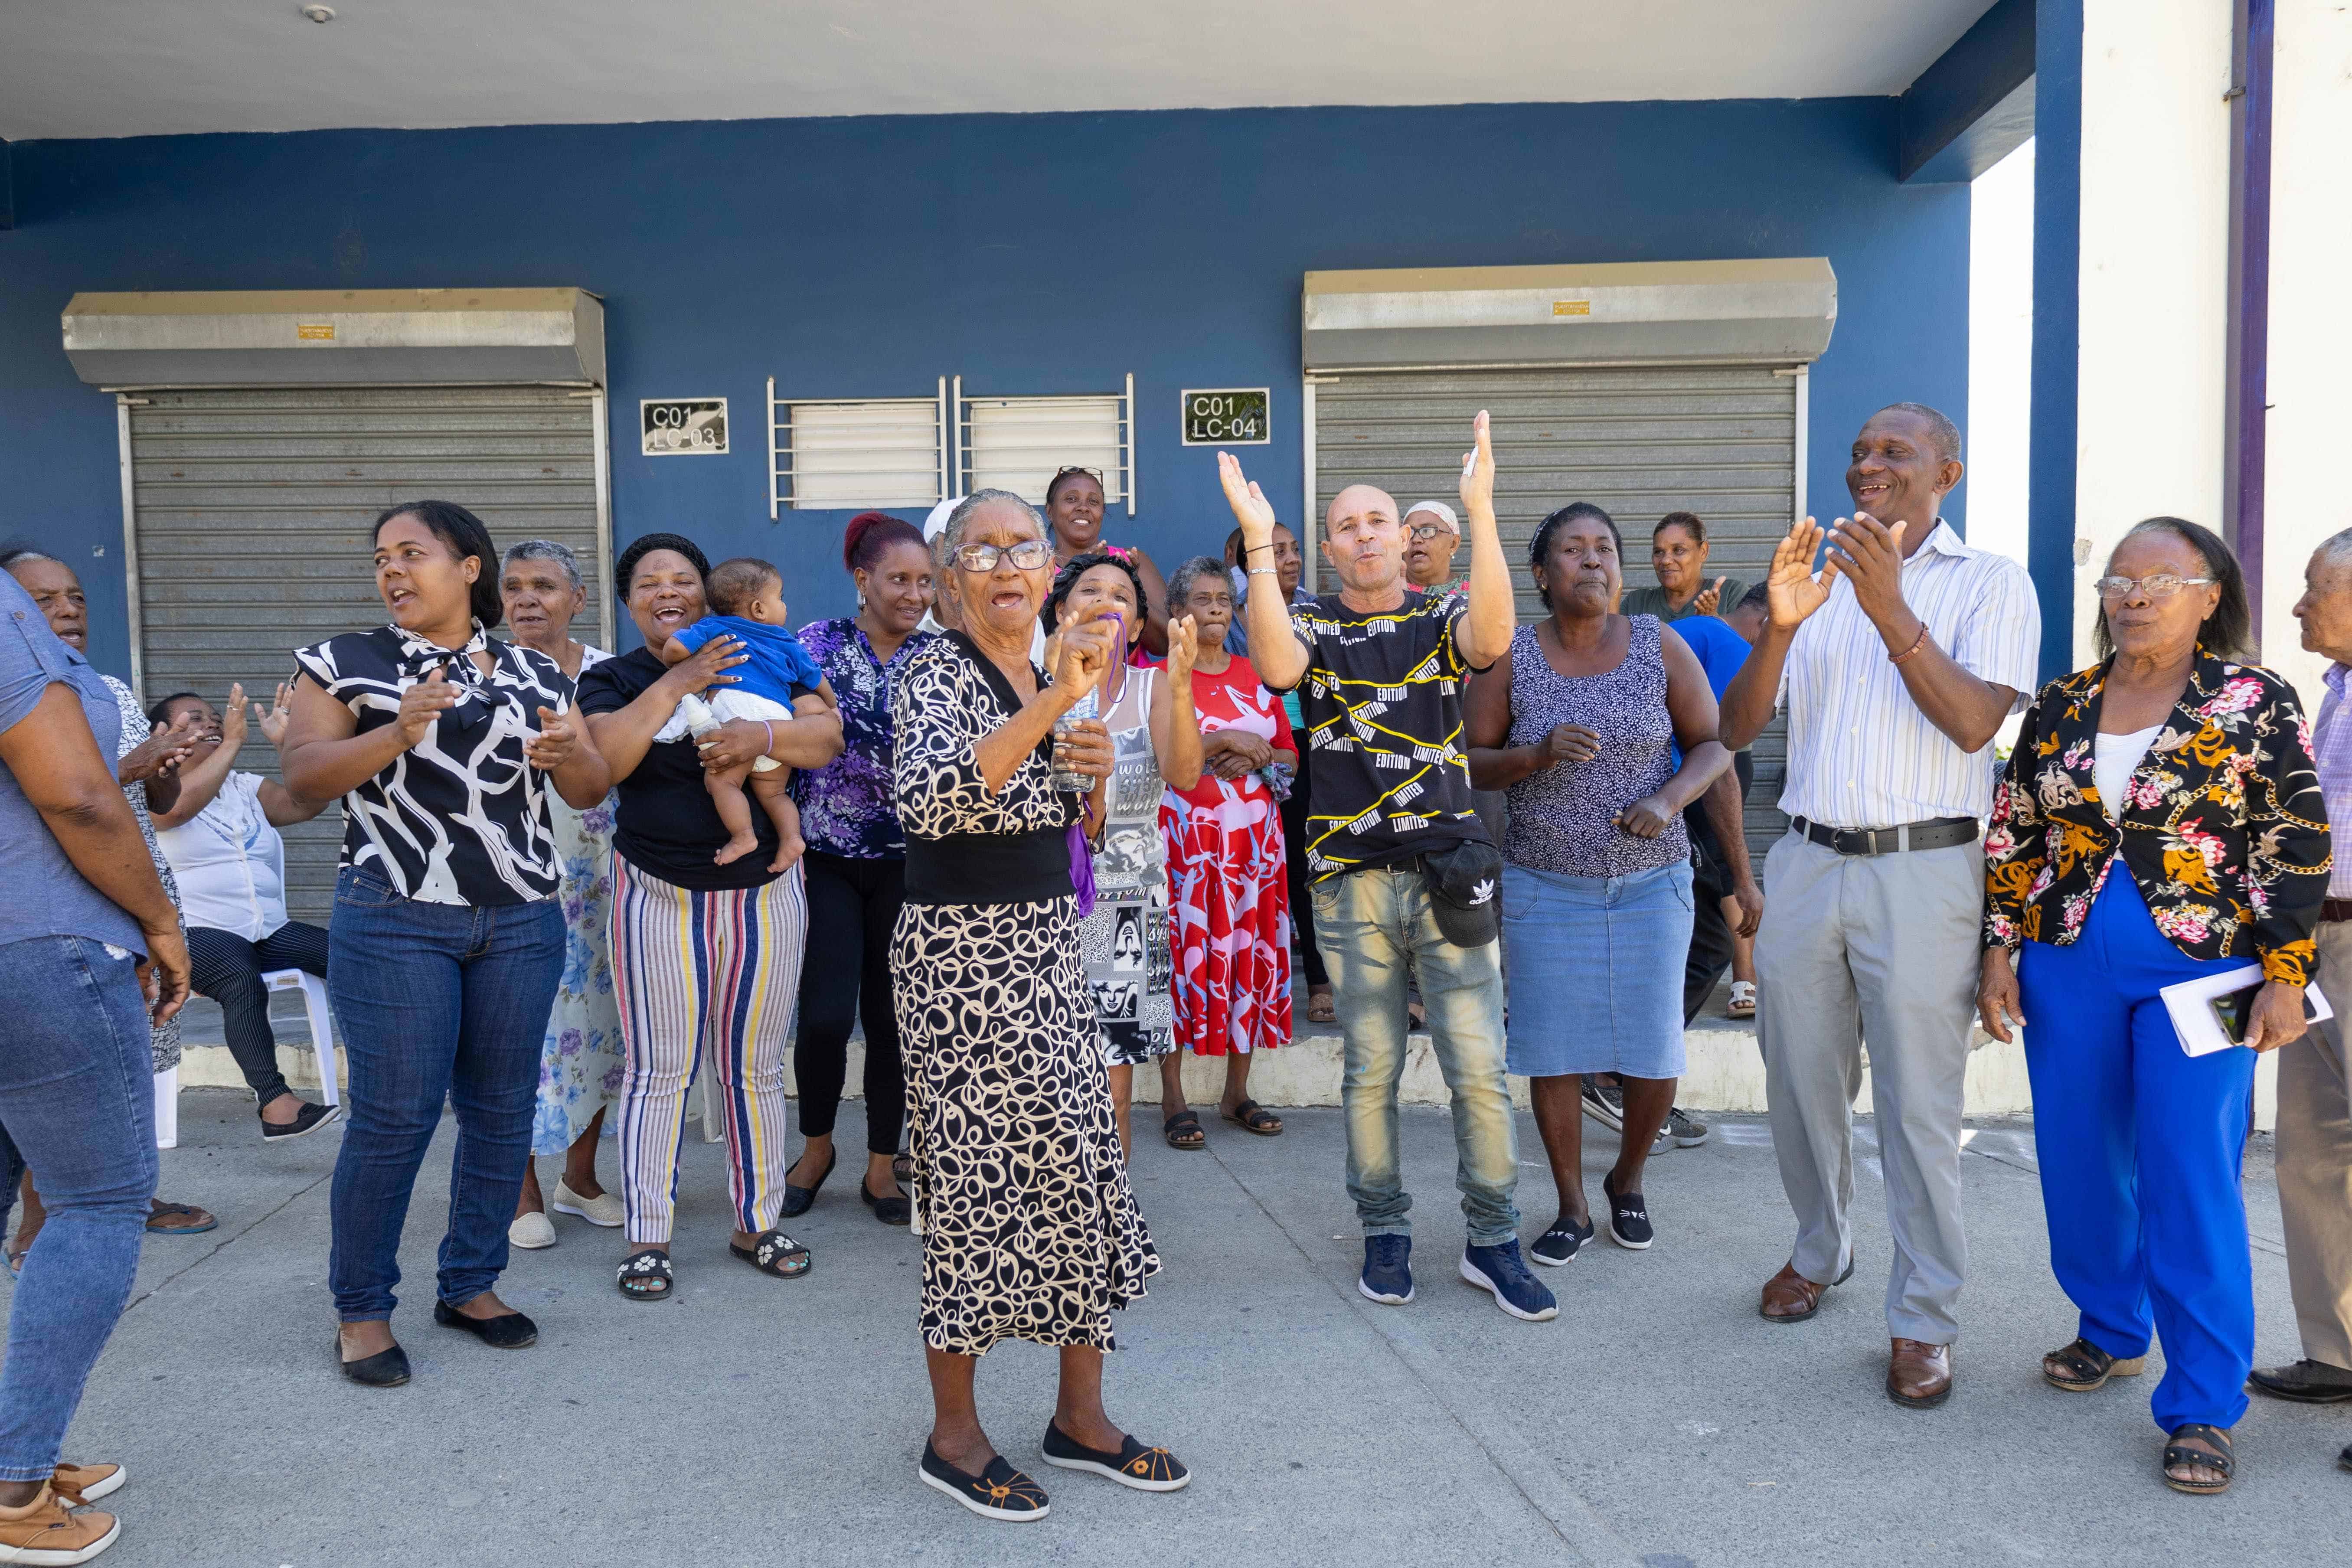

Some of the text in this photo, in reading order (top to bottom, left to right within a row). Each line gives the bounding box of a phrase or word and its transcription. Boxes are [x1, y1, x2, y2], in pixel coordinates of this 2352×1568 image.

[653, 406, 692, 426] C01
[1194, 397, 1233, 416] C01
[654, 428, 715, 448] LC-03
[1194, 418, 1257, 438] LC-04
[1312, 617, 1340, 636] LMITED
[1377, 685, 1408, 702] EDITION
[1375, 753, 1411, 770] EDITION
[1413, 745, 1444, 766] LIMITED
[1348, 809, 1429, 836] EDITION LIMITED
